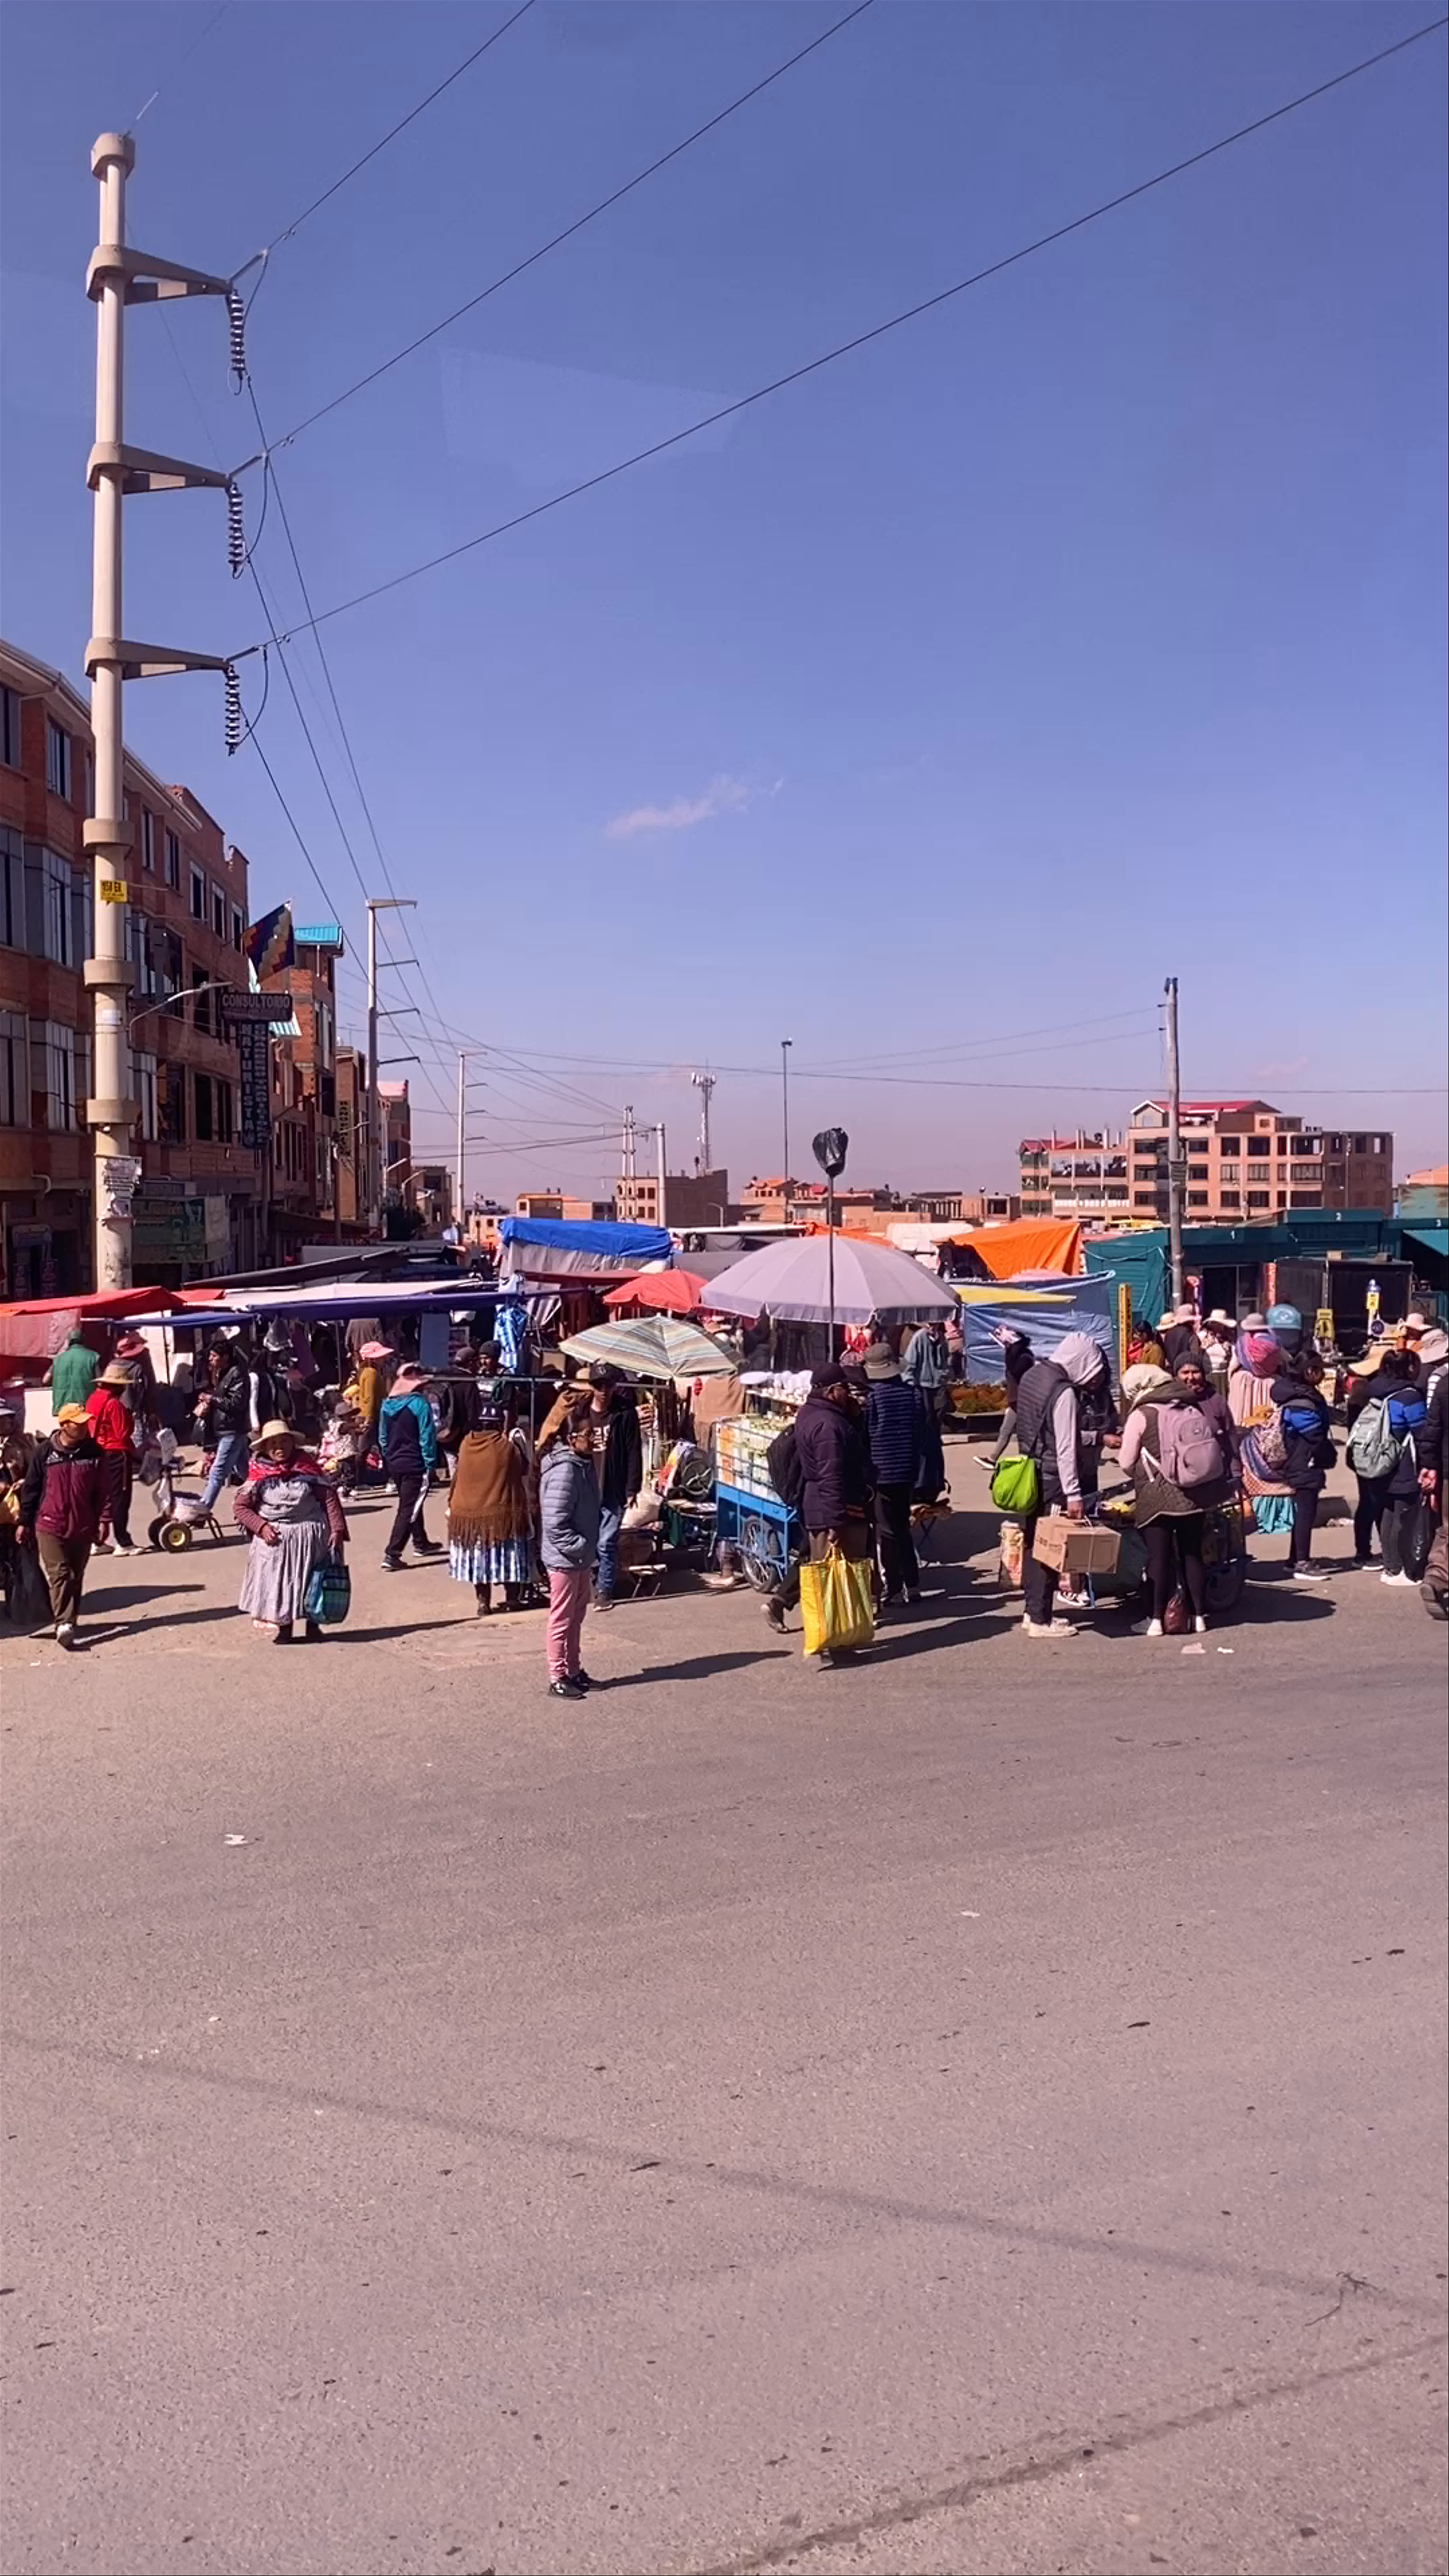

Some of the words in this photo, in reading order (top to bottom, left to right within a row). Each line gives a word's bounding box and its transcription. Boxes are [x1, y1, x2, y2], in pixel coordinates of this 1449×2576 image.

[222, 994, 290, 1009] CONSULTORIO
[242, 1024, 254, 1130] NATURISTA
[1336, 1212, 1341, 1221] 2
[1231, 1230, 1235, 1240] 1
